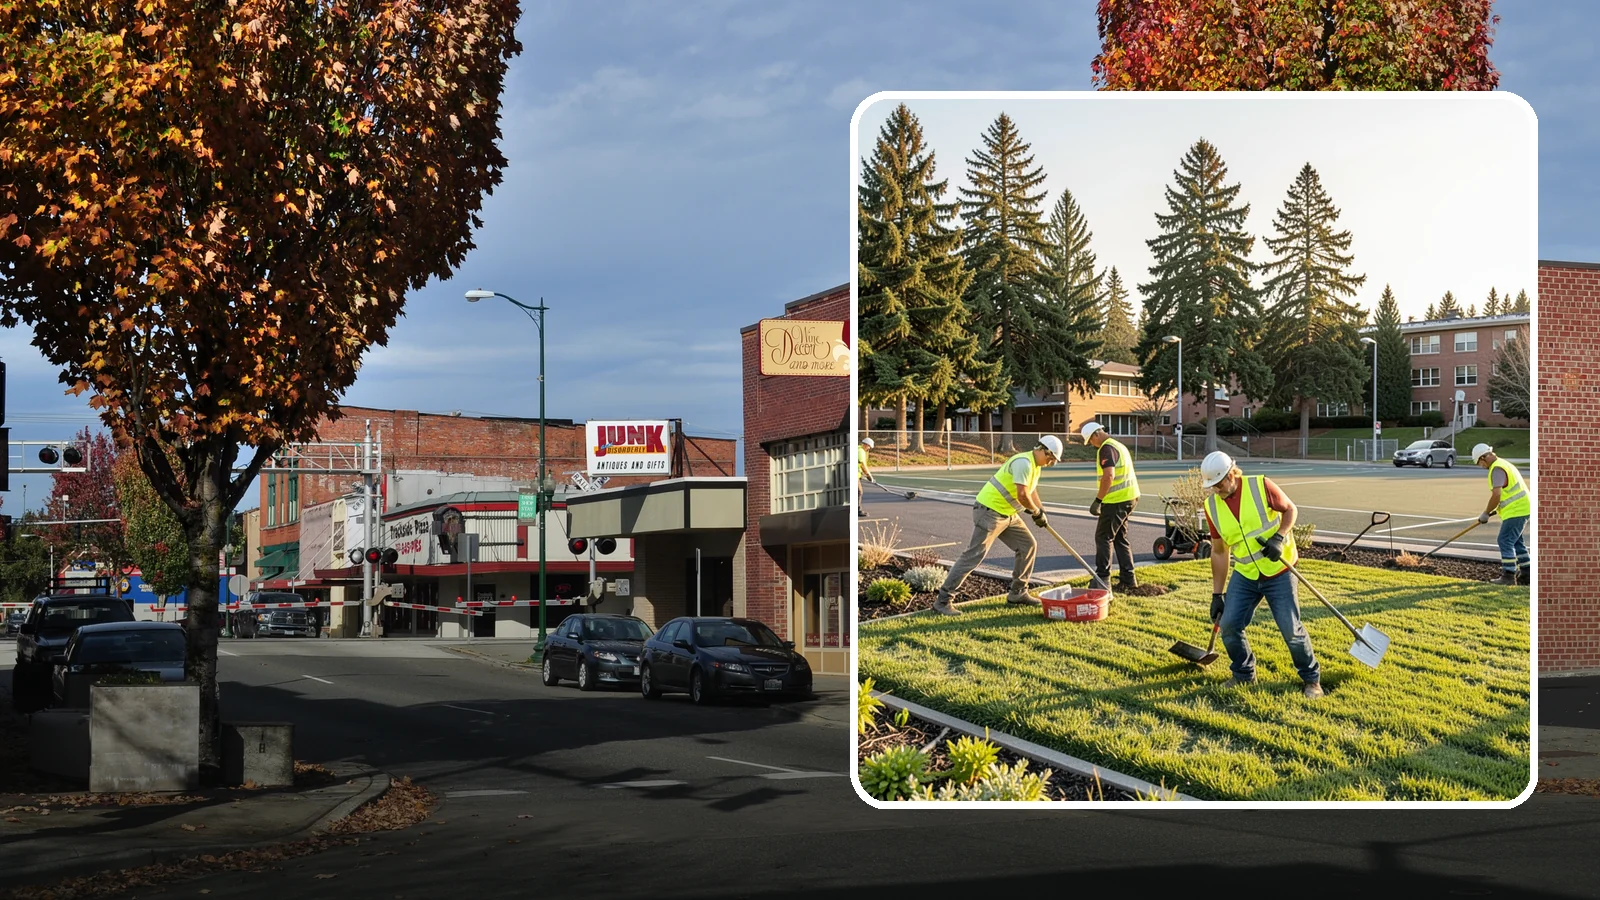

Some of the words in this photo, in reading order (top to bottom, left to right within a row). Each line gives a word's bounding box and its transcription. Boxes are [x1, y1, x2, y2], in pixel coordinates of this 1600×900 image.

[765, 327, 831, 365] Decor
[596, 425, 665, 457] JUNK
[607, 446, 645, 454] DISORDERLY
[597, 461, 628, 470] ANTIQUES
[631, 461, 644, 470] AND
[647, 460, 665, 469] GIFTS
[352, 498, 365, 510] CRO
[390, 521, 413, 539] Trackside
[414, 519, 429, 534] Pizza
